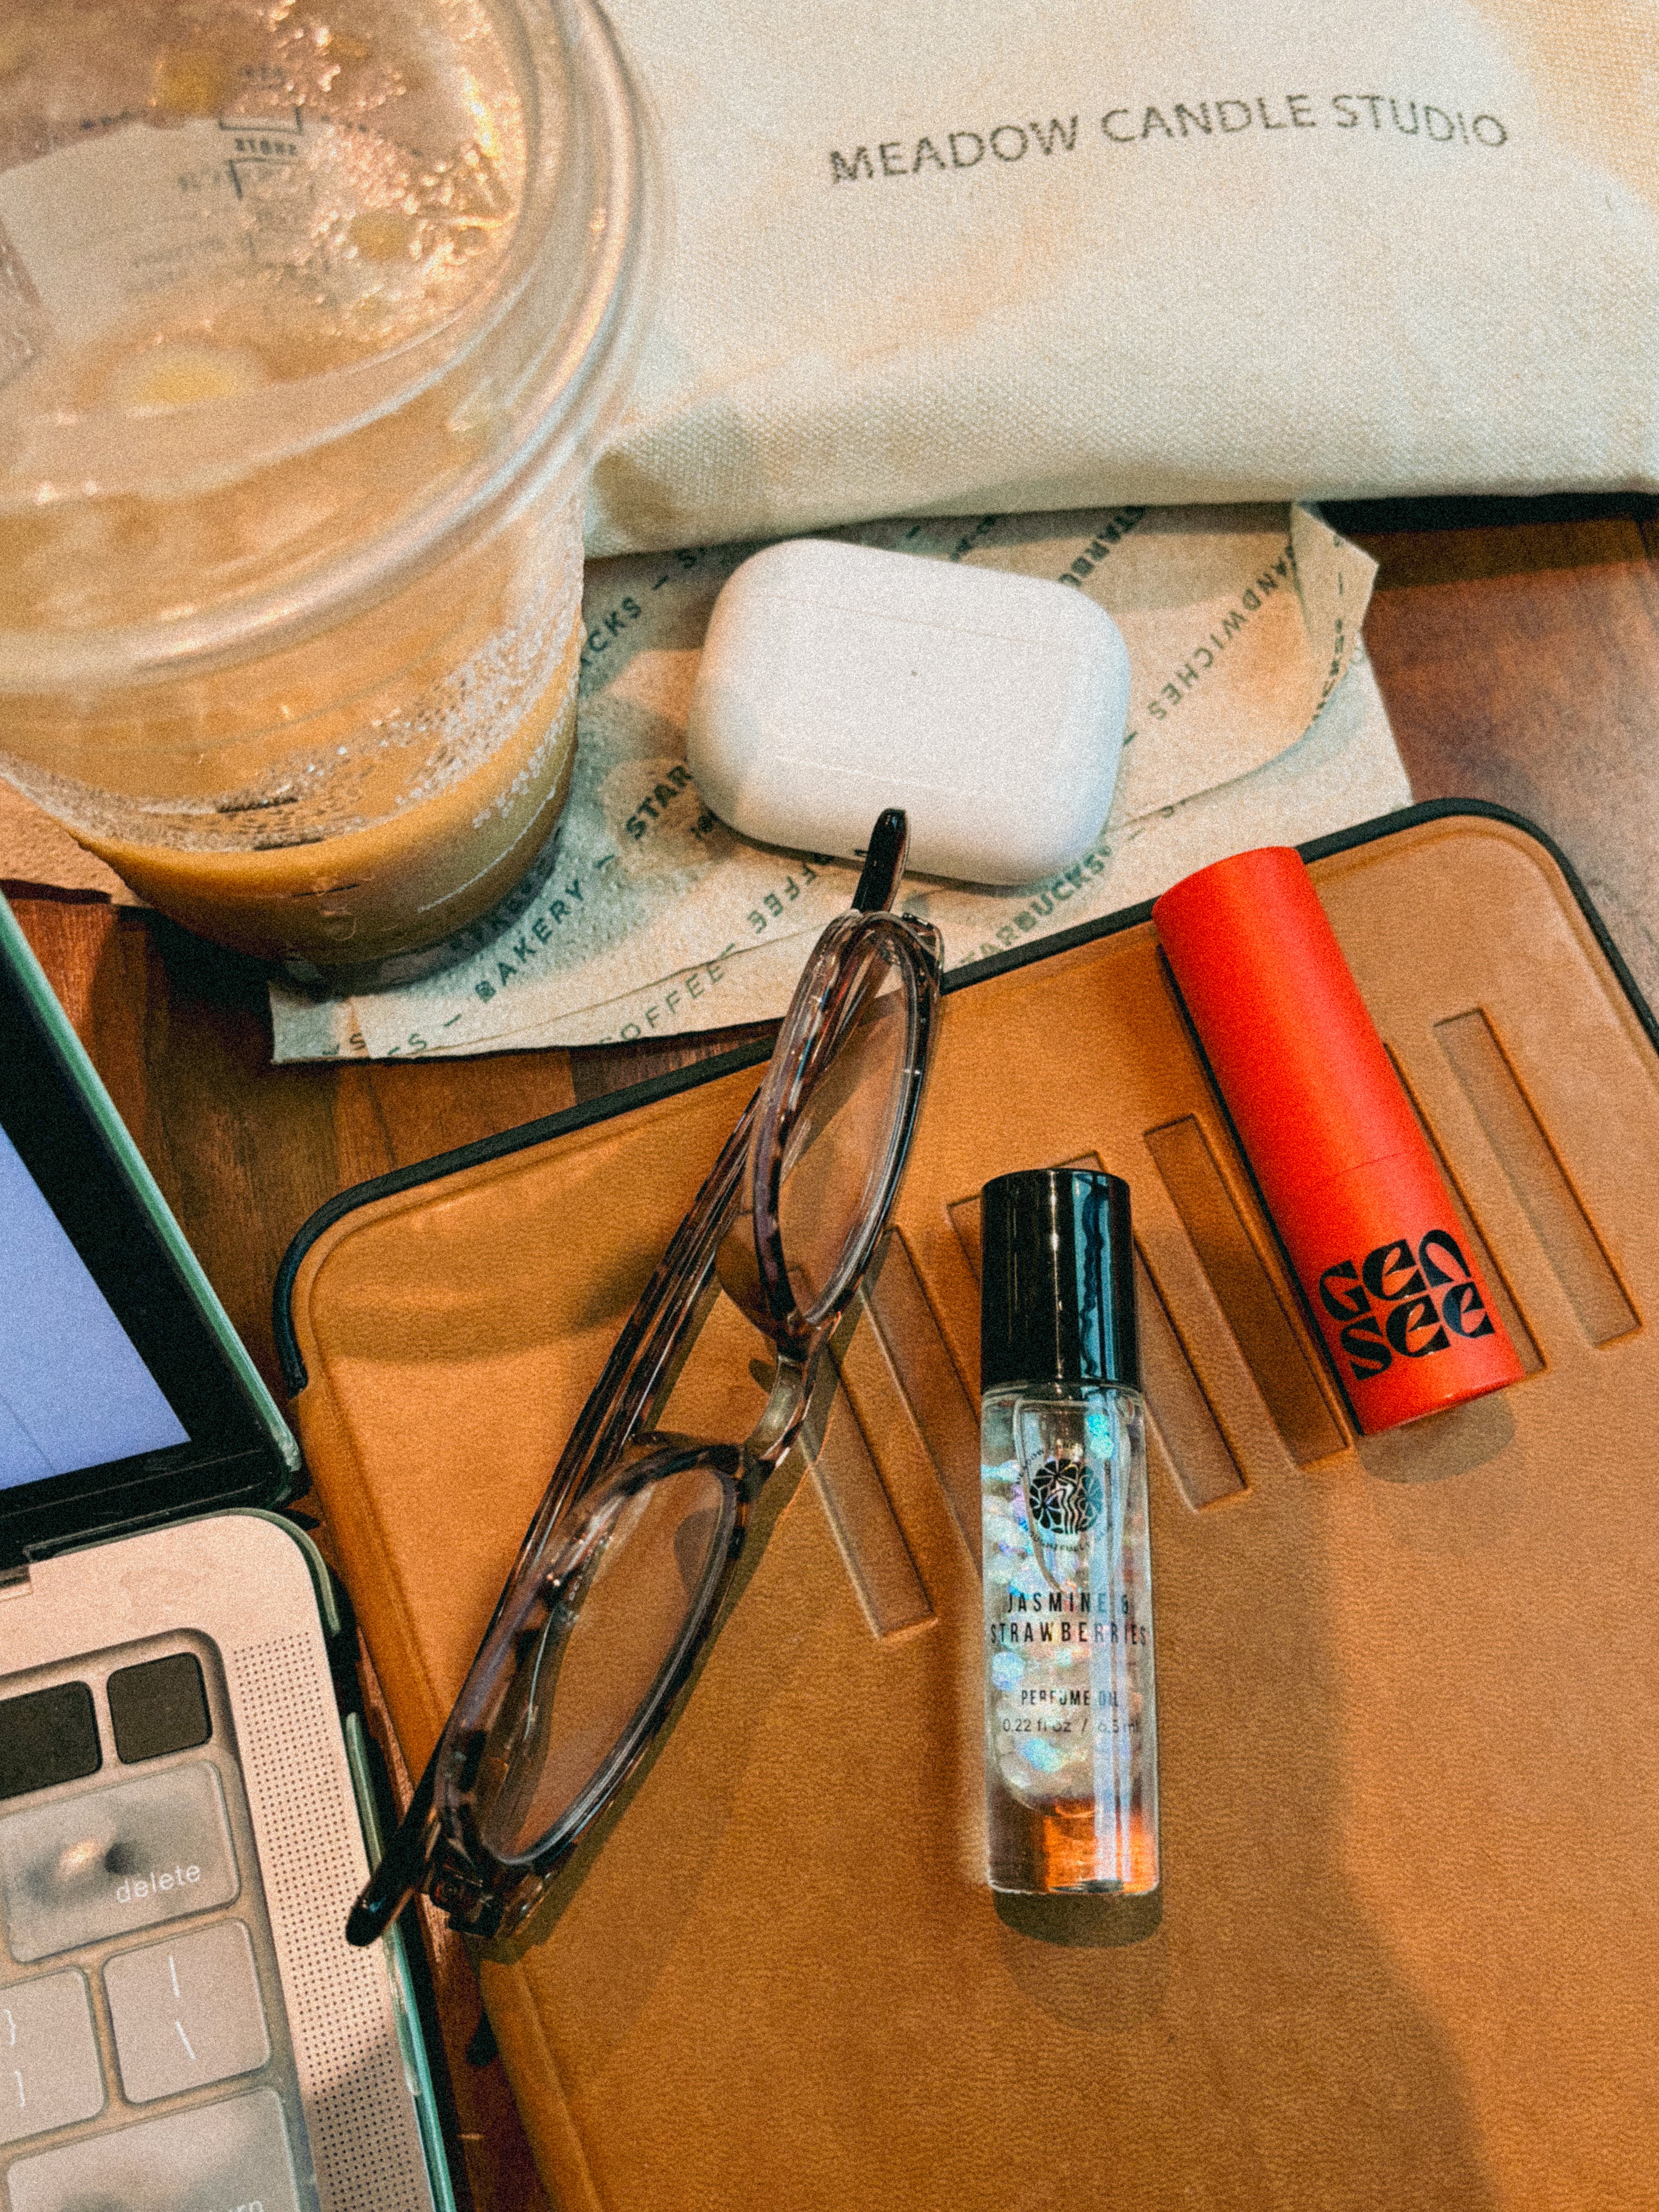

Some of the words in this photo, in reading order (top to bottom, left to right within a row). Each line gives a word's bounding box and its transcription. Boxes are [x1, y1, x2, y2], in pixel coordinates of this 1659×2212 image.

[829, 115, 1078, 184] MEADOW
[1101, 94, 1316, 143] CANDLE
[1332, 94, 1508, 147] STUDIO
[475, 879, 583, 1003] BAKERY
[1008, 1592, 1107, 1613] JASMINE
[991, 1621, 1147, 1646] STRAWBERRIES
[1021, 1690, 1090, 1706] PERFUME
[1099, 1690, 1119, 1707] OIL
[1003, 1718, 1032, 1732] 0.22
[116, 1865, 201, 1904] delete
